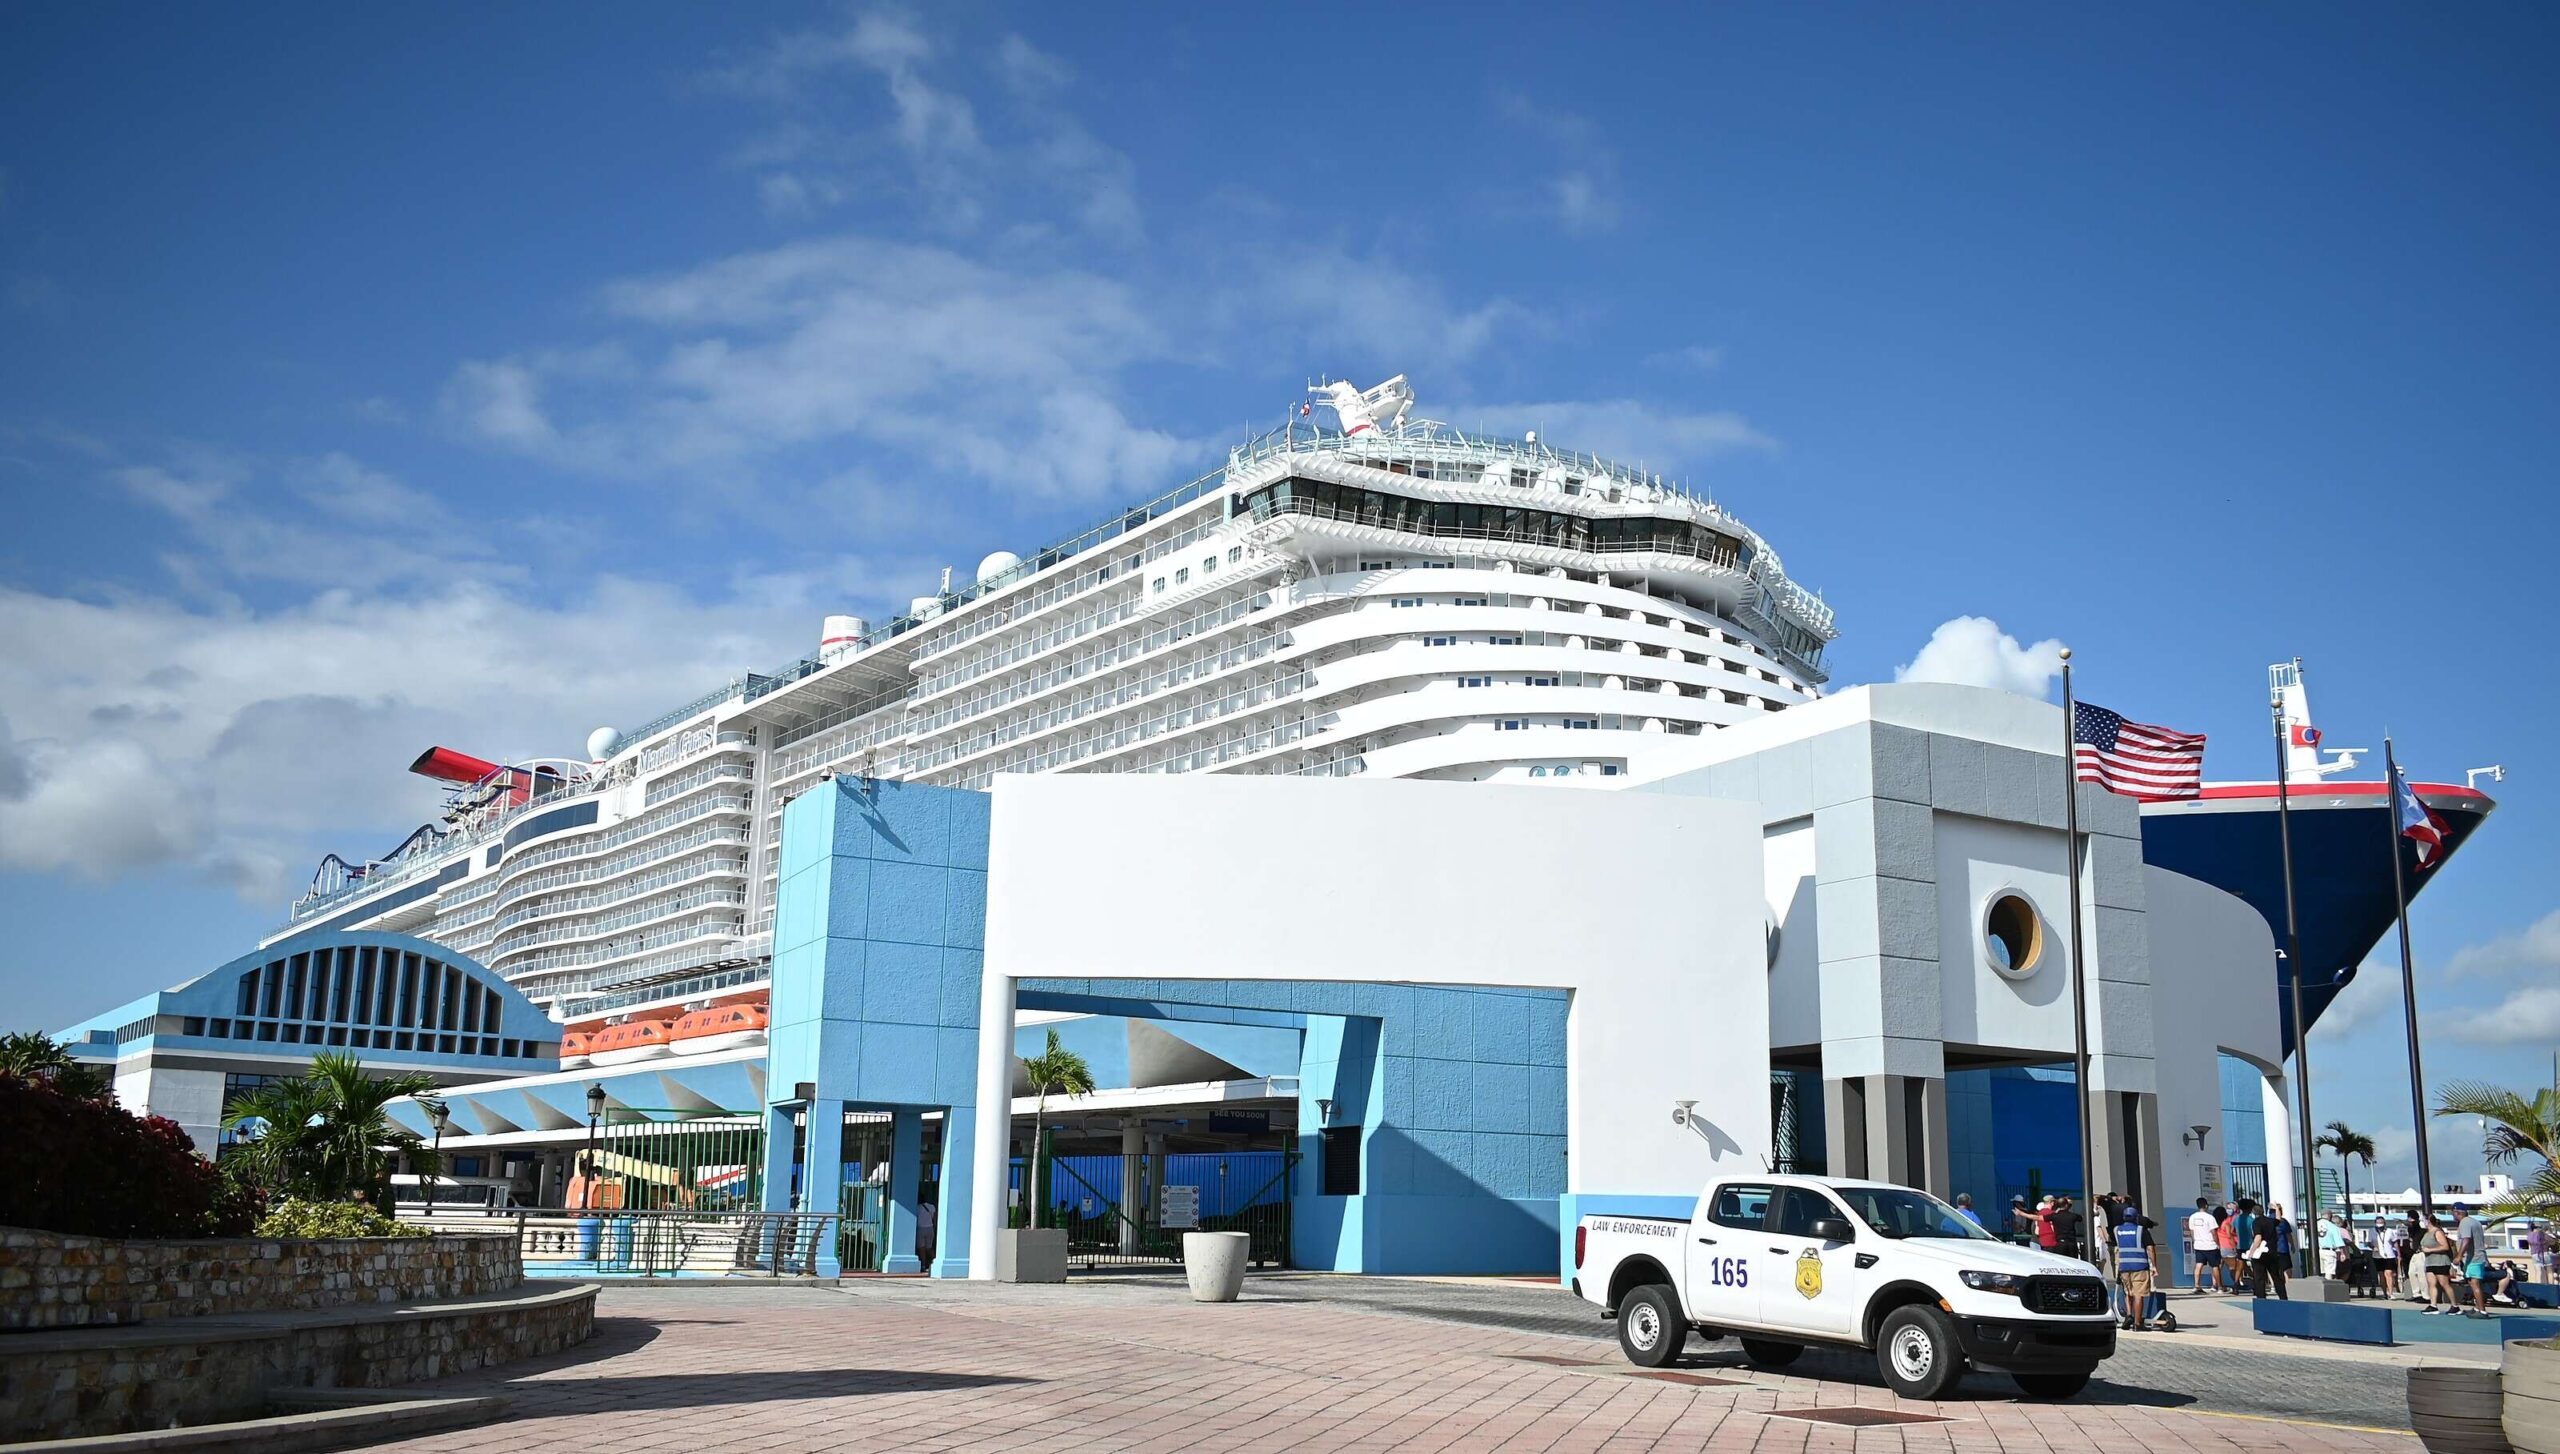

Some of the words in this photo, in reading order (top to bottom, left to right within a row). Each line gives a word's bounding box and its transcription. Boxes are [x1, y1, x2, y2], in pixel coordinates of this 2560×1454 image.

[640, 735, 678, 773] Mardi
[680, 725, 713, 753] Gras
[1230, 1110, 1246, 1118] YOU
[1592, 1220, 1610, 1232] LAW
[1612, 1221, 1678, 1238] ENFORCEMENT
[1711, 1256, 1748, 1288] 165
